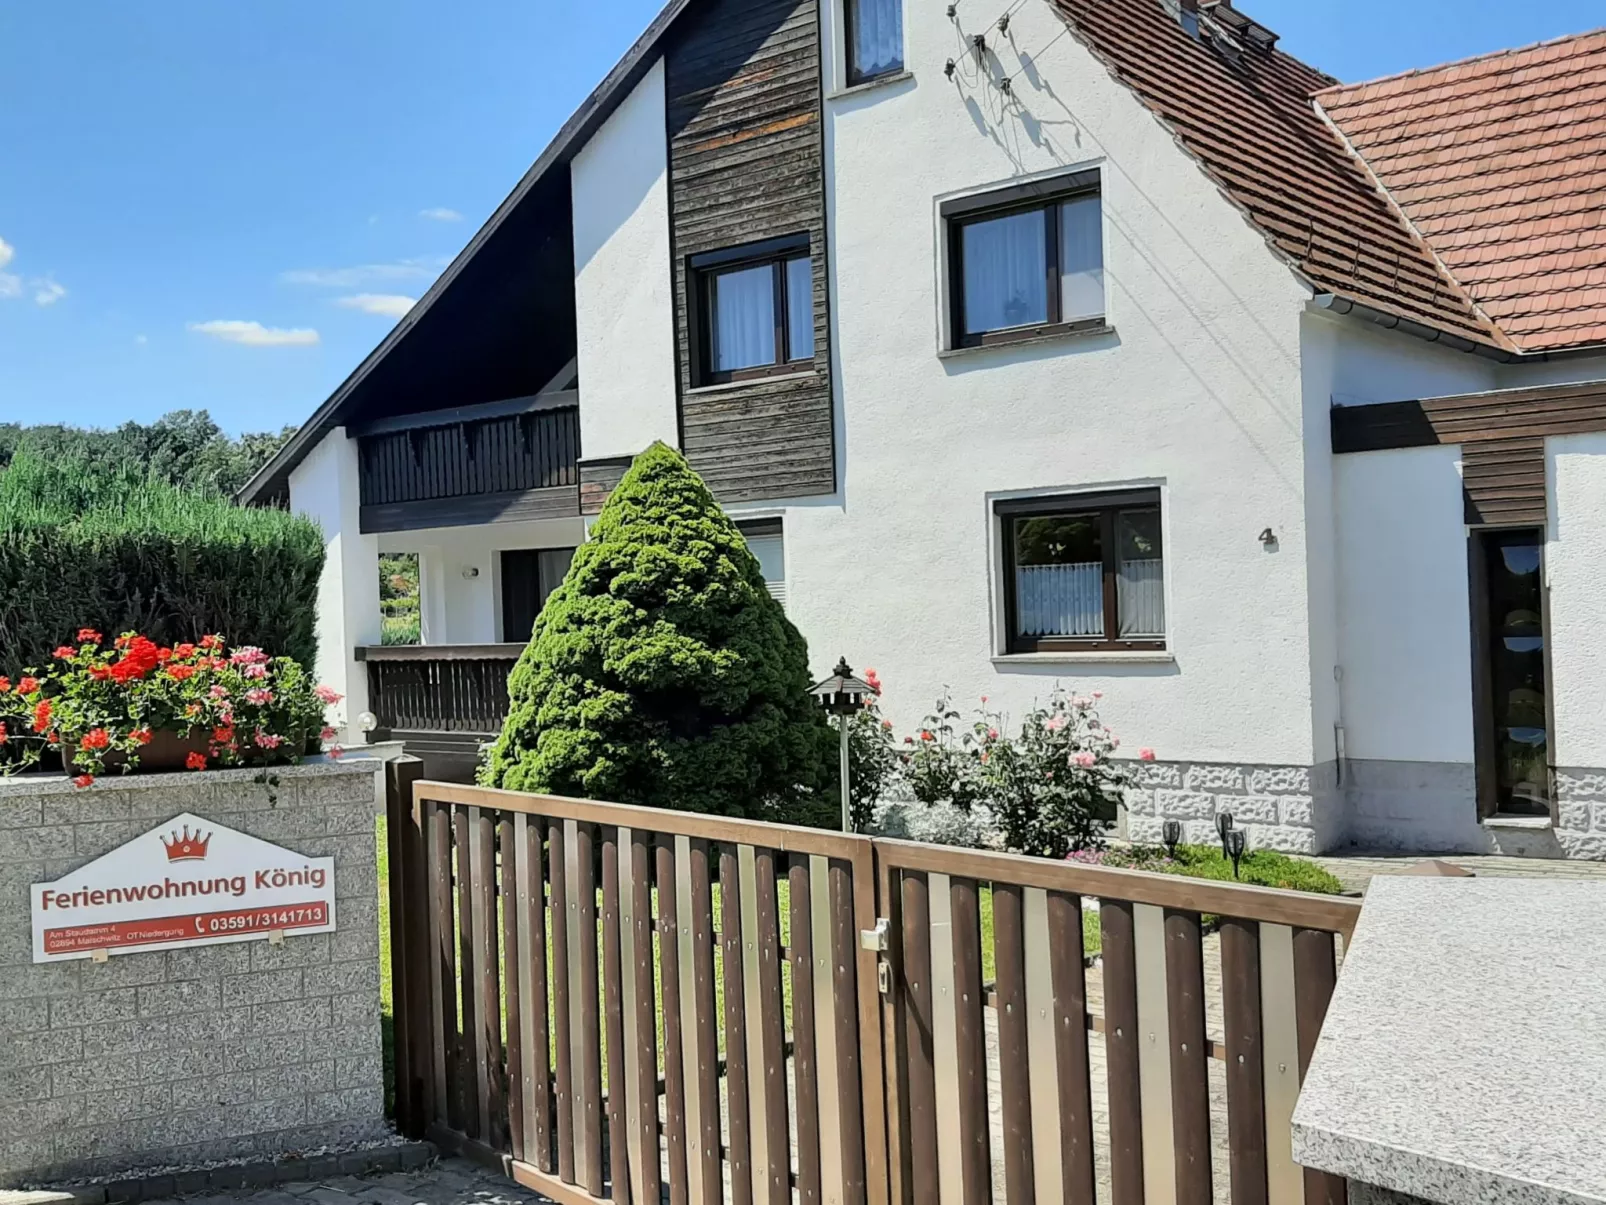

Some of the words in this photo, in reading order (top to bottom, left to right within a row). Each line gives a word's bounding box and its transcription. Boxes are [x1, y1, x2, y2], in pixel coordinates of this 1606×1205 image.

[1258, 527, 1277, 545] 4
[41, 874, 246, 911] Ferienwohnung
[254, 865, 326, 890] König
[210, 907, 322, 931] 03591/3141713
[49, 931, 63, 939] Am
